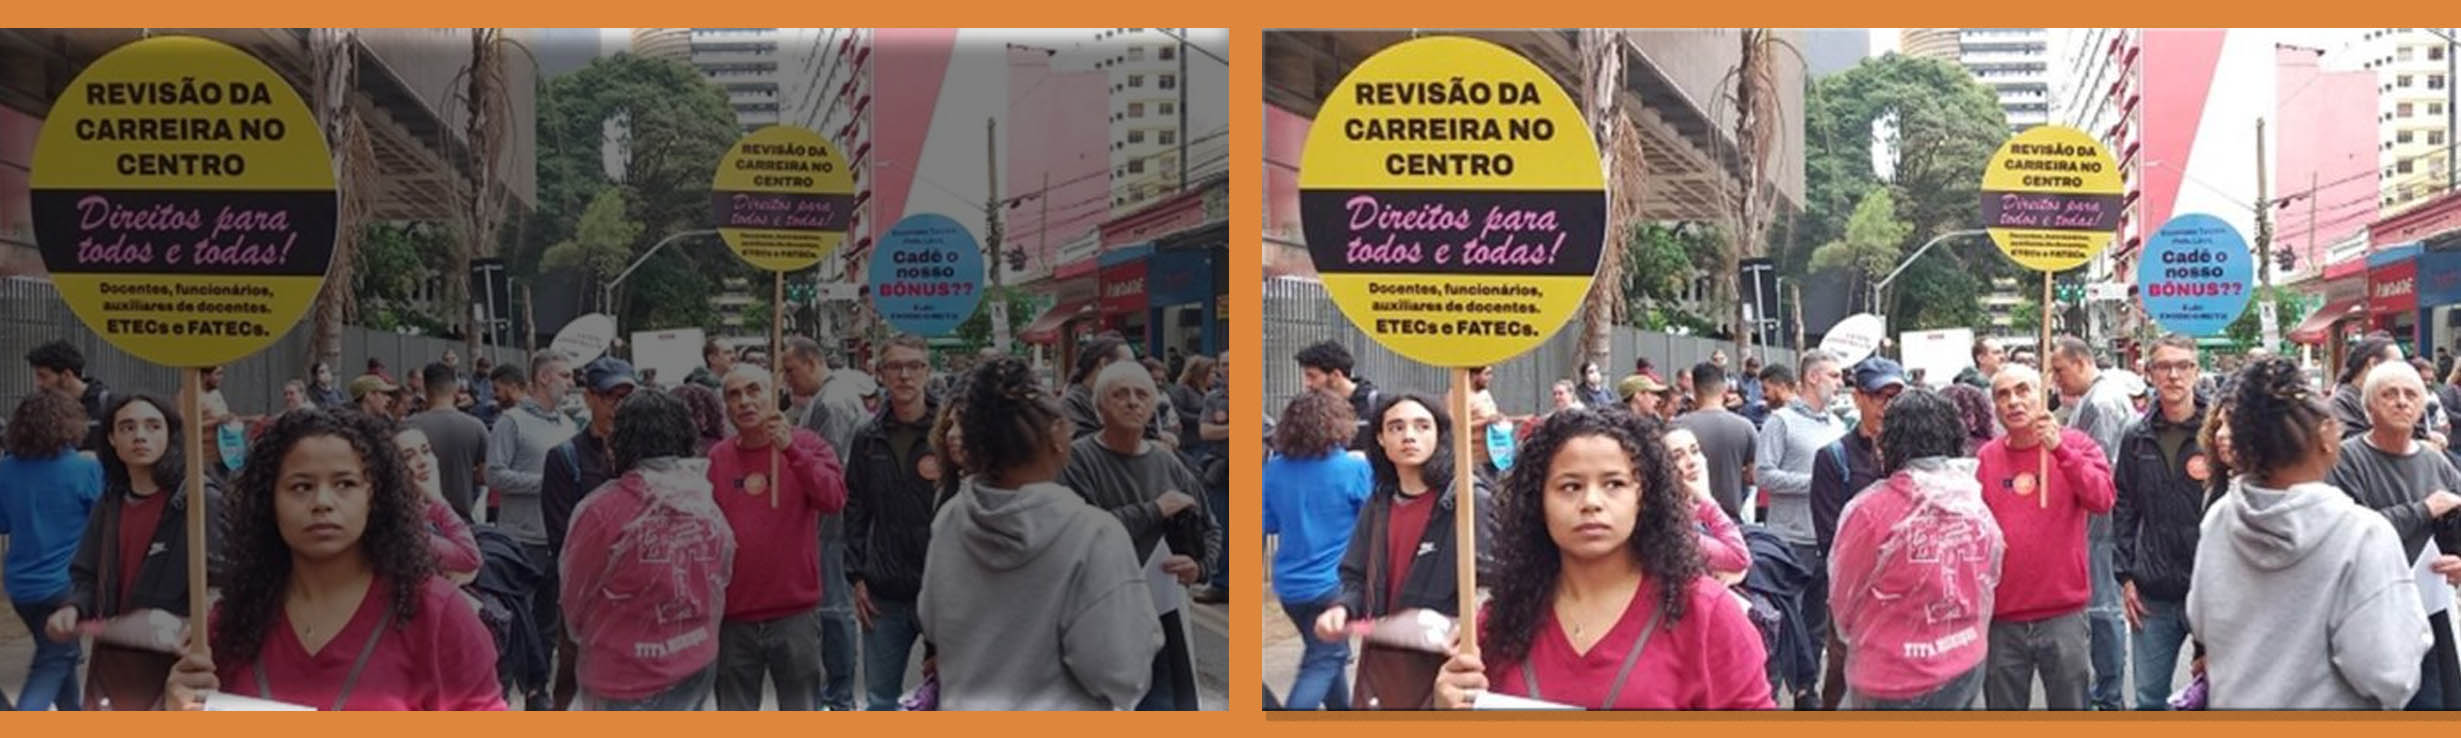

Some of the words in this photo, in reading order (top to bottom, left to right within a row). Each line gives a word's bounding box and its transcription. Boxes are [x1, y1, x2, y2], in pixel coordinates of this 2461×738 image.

[86, 77, 223, 106] REVISÃO
[229, 82, 272, 106] DA
[1355, 77, 1492, 106] REVISÃO
[1498, 82, 1541, 106] DA
[75, 118, 234, 141] CARREIRA
[239, 118, 286, 141] NO
[1344, 118, 1503, 141] CARREIRA
[1508, 118, 1555, 141] NO
[741, 142, 806, 156] REVISÃO
[808, 146, 828, 157] DA
[2010, 142, 2075, 156] REVISÃO
[2077, 146, 2097, 157] DA
[117, 153, 246, 176] CENTRO
[735, 159, 809, 172] CARREIRA
[812, 162, 833, 173] NO
[1386, 153, 1515, 176] CENTRO
[2004, 159, 2078, 172] CARREIRA
[2081, 162, 2102, 173] NO
[754, 175, 814, 187] CENTRO
[2023, 175, 2083, 187] CENTRO
[77, 195, 202, 231] Direitos
[212, 205, 291, 239] para
[1346, 195, 1471, 231] Direitos
[1481, 205, 1560, 239] para
[77, 233, 156, 265] todos
[165, 243, 182, 263] e
[193, 231, 298, 265] todas!
[1346, 233, 1425, 265] todos
[1434, 243, 1451, 263] e
[1462, 231, 1567, 265] todas!
[946, 251, 959, 263] o
[2215, 251, 2228, 263] o
[897, 266, 955, 279] nosso
[2166, 266, 2224, 279] nosso
[100, 282, 173, 297] Docentes,
[175, 282, 274, 298] funcionários,
[879, 280, 974, 297] BÔNUS??
[1369, 282, 1442, 297] Docentes,
[1444, 282, 1543, 298] funcionários,
[2148, 280, 2243, 297] BÔNUS??
[103, 301, 174, 313] auxiliares
[176, 302, 194, 313] de
[196, 302, 272, 314] docentes.
[1372, 301, 1443, 313] auxiliares
[1445, 302, 1463, 313] de
[1465, 302, 1541, 314] docentes.
[106, 319, 170, 335] ETECs
[172, 323, 183, 335] e
[188, 320, 270, 336] FATECs.
[1375, 319, 1439, 335] ETECs
[1441, 323, 1452, 335] e
[1457, 320, 1539, 336] FATECs.
